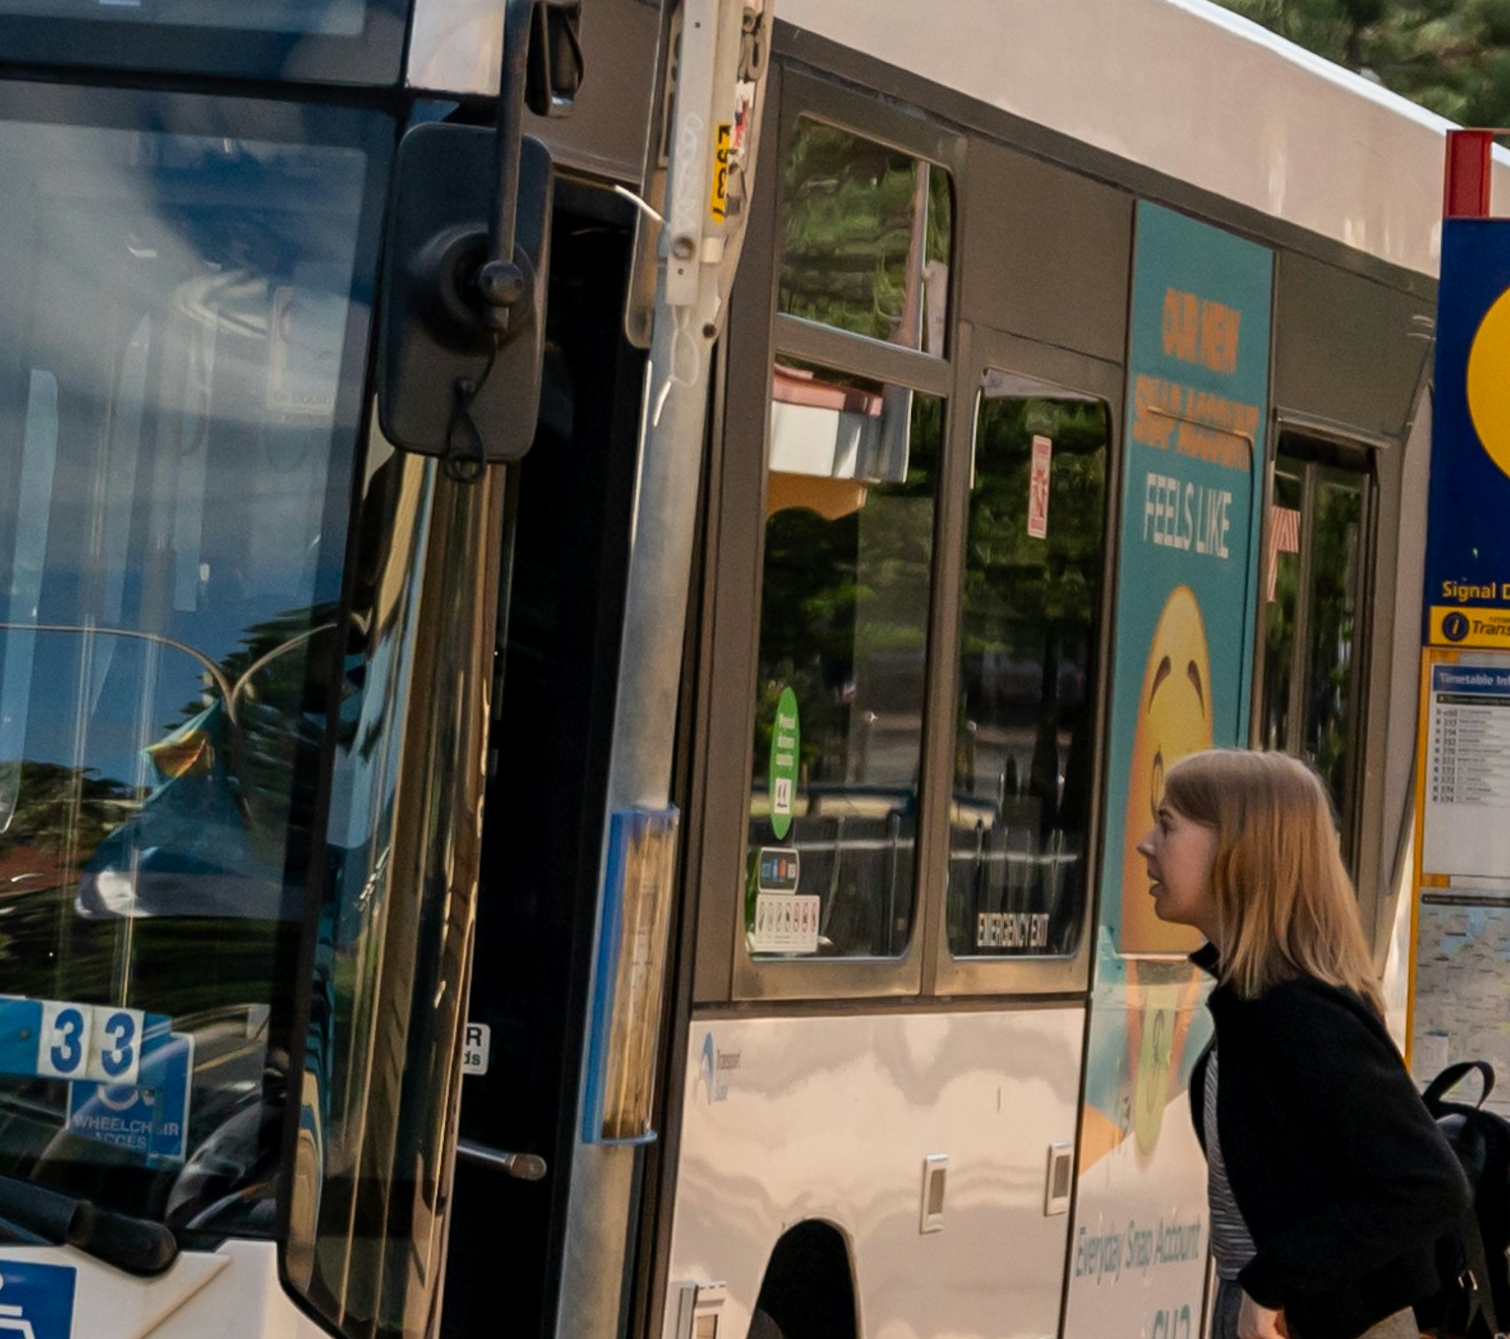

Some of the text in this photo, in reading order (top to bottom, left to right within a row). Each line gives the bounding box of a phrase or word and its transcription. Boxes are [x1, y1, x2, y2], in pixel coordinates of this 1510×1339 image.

[1143, 472, 1232, 559] FEELS LIKE
[1441, 580, 1496, 603] Signal
[49, 1007, 136, 1077] 33
[73, 1114, 180, 1137] WHEELCHIR
[1154, 1216, 1201, 1266] Account
